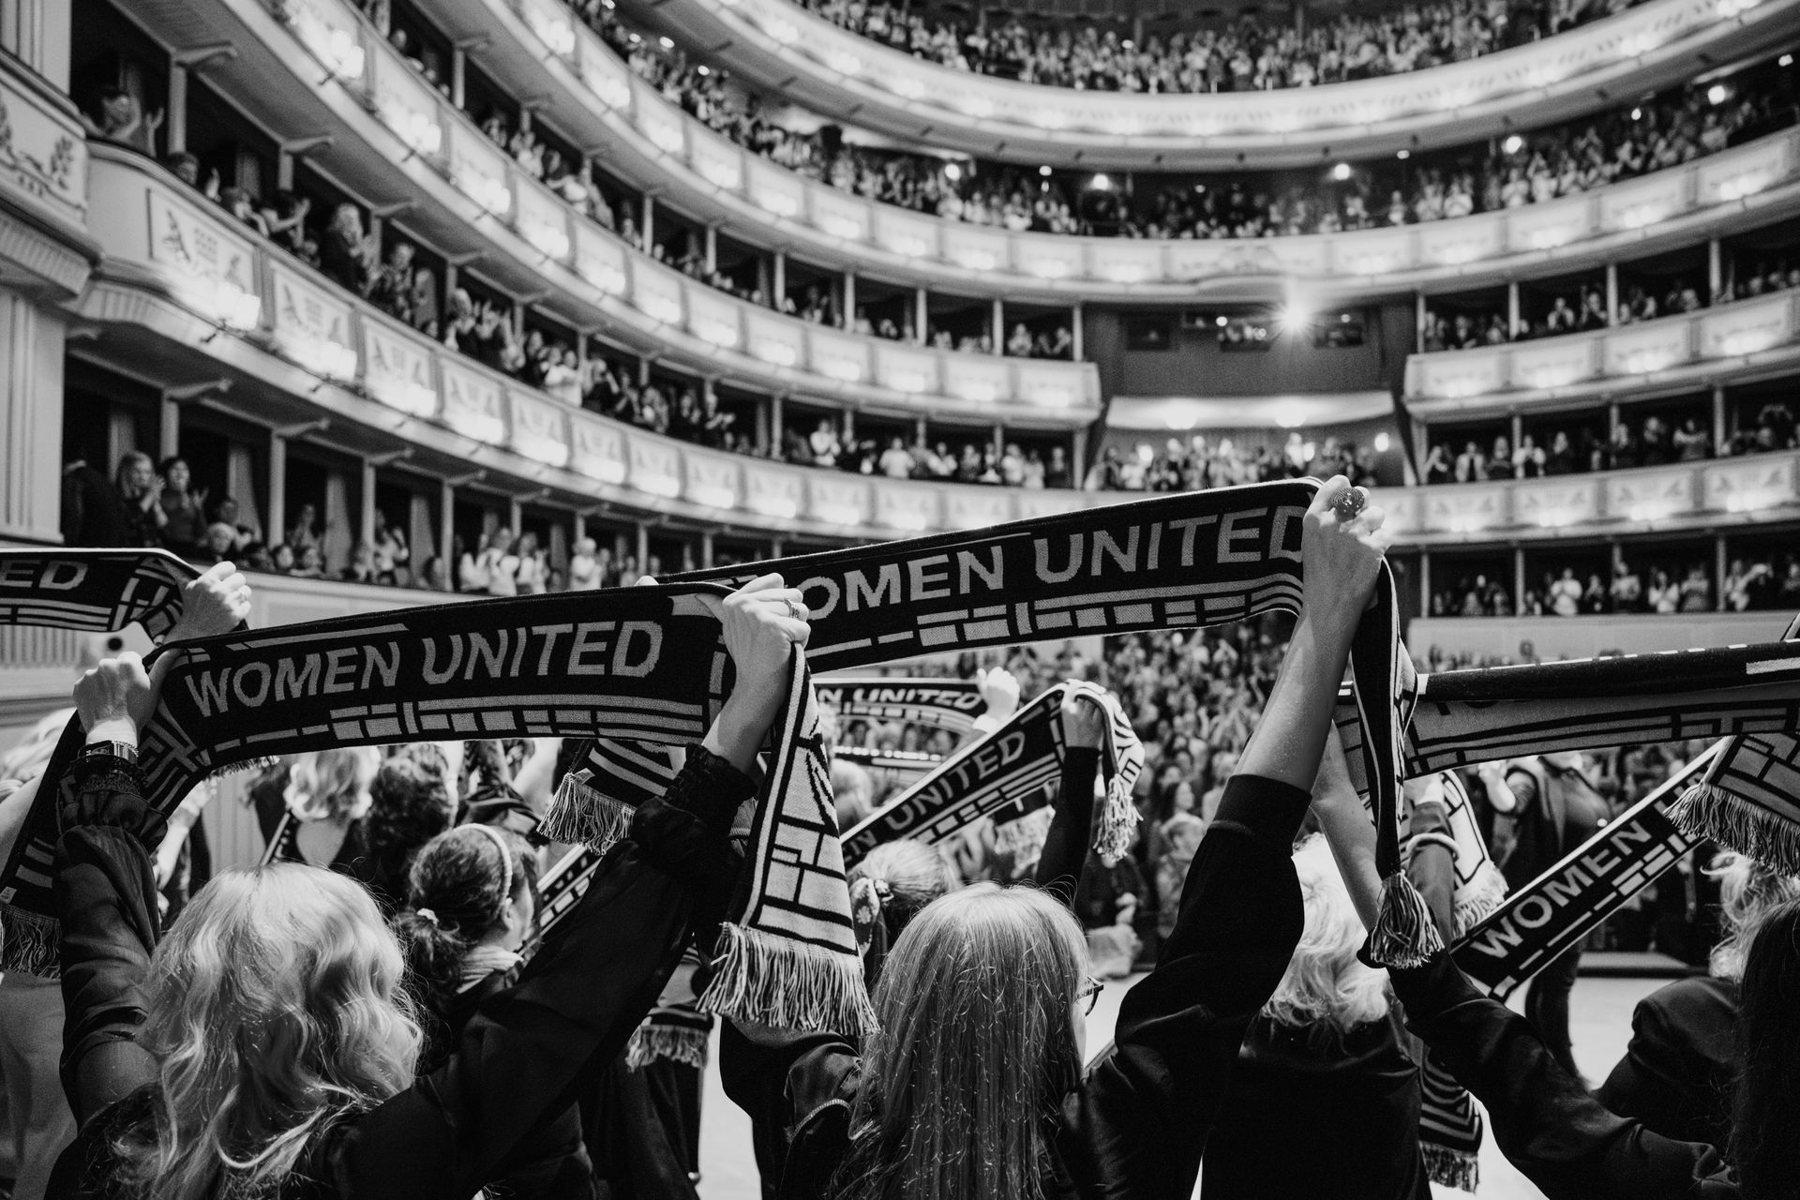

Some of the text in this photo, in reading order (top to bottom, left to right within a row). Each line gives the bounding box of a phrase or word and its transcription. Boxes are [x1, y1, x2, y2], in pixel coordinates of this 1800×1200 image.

[794, 505, 1304, 621] OMEN UNITED
[184, 620, 664, 718] WOMEN UNITED
[852, 688, 982, 710] UNITED
[884, 730, 1026, 831] UNITED
[1469, 819, 1652, 959] WOMEN
